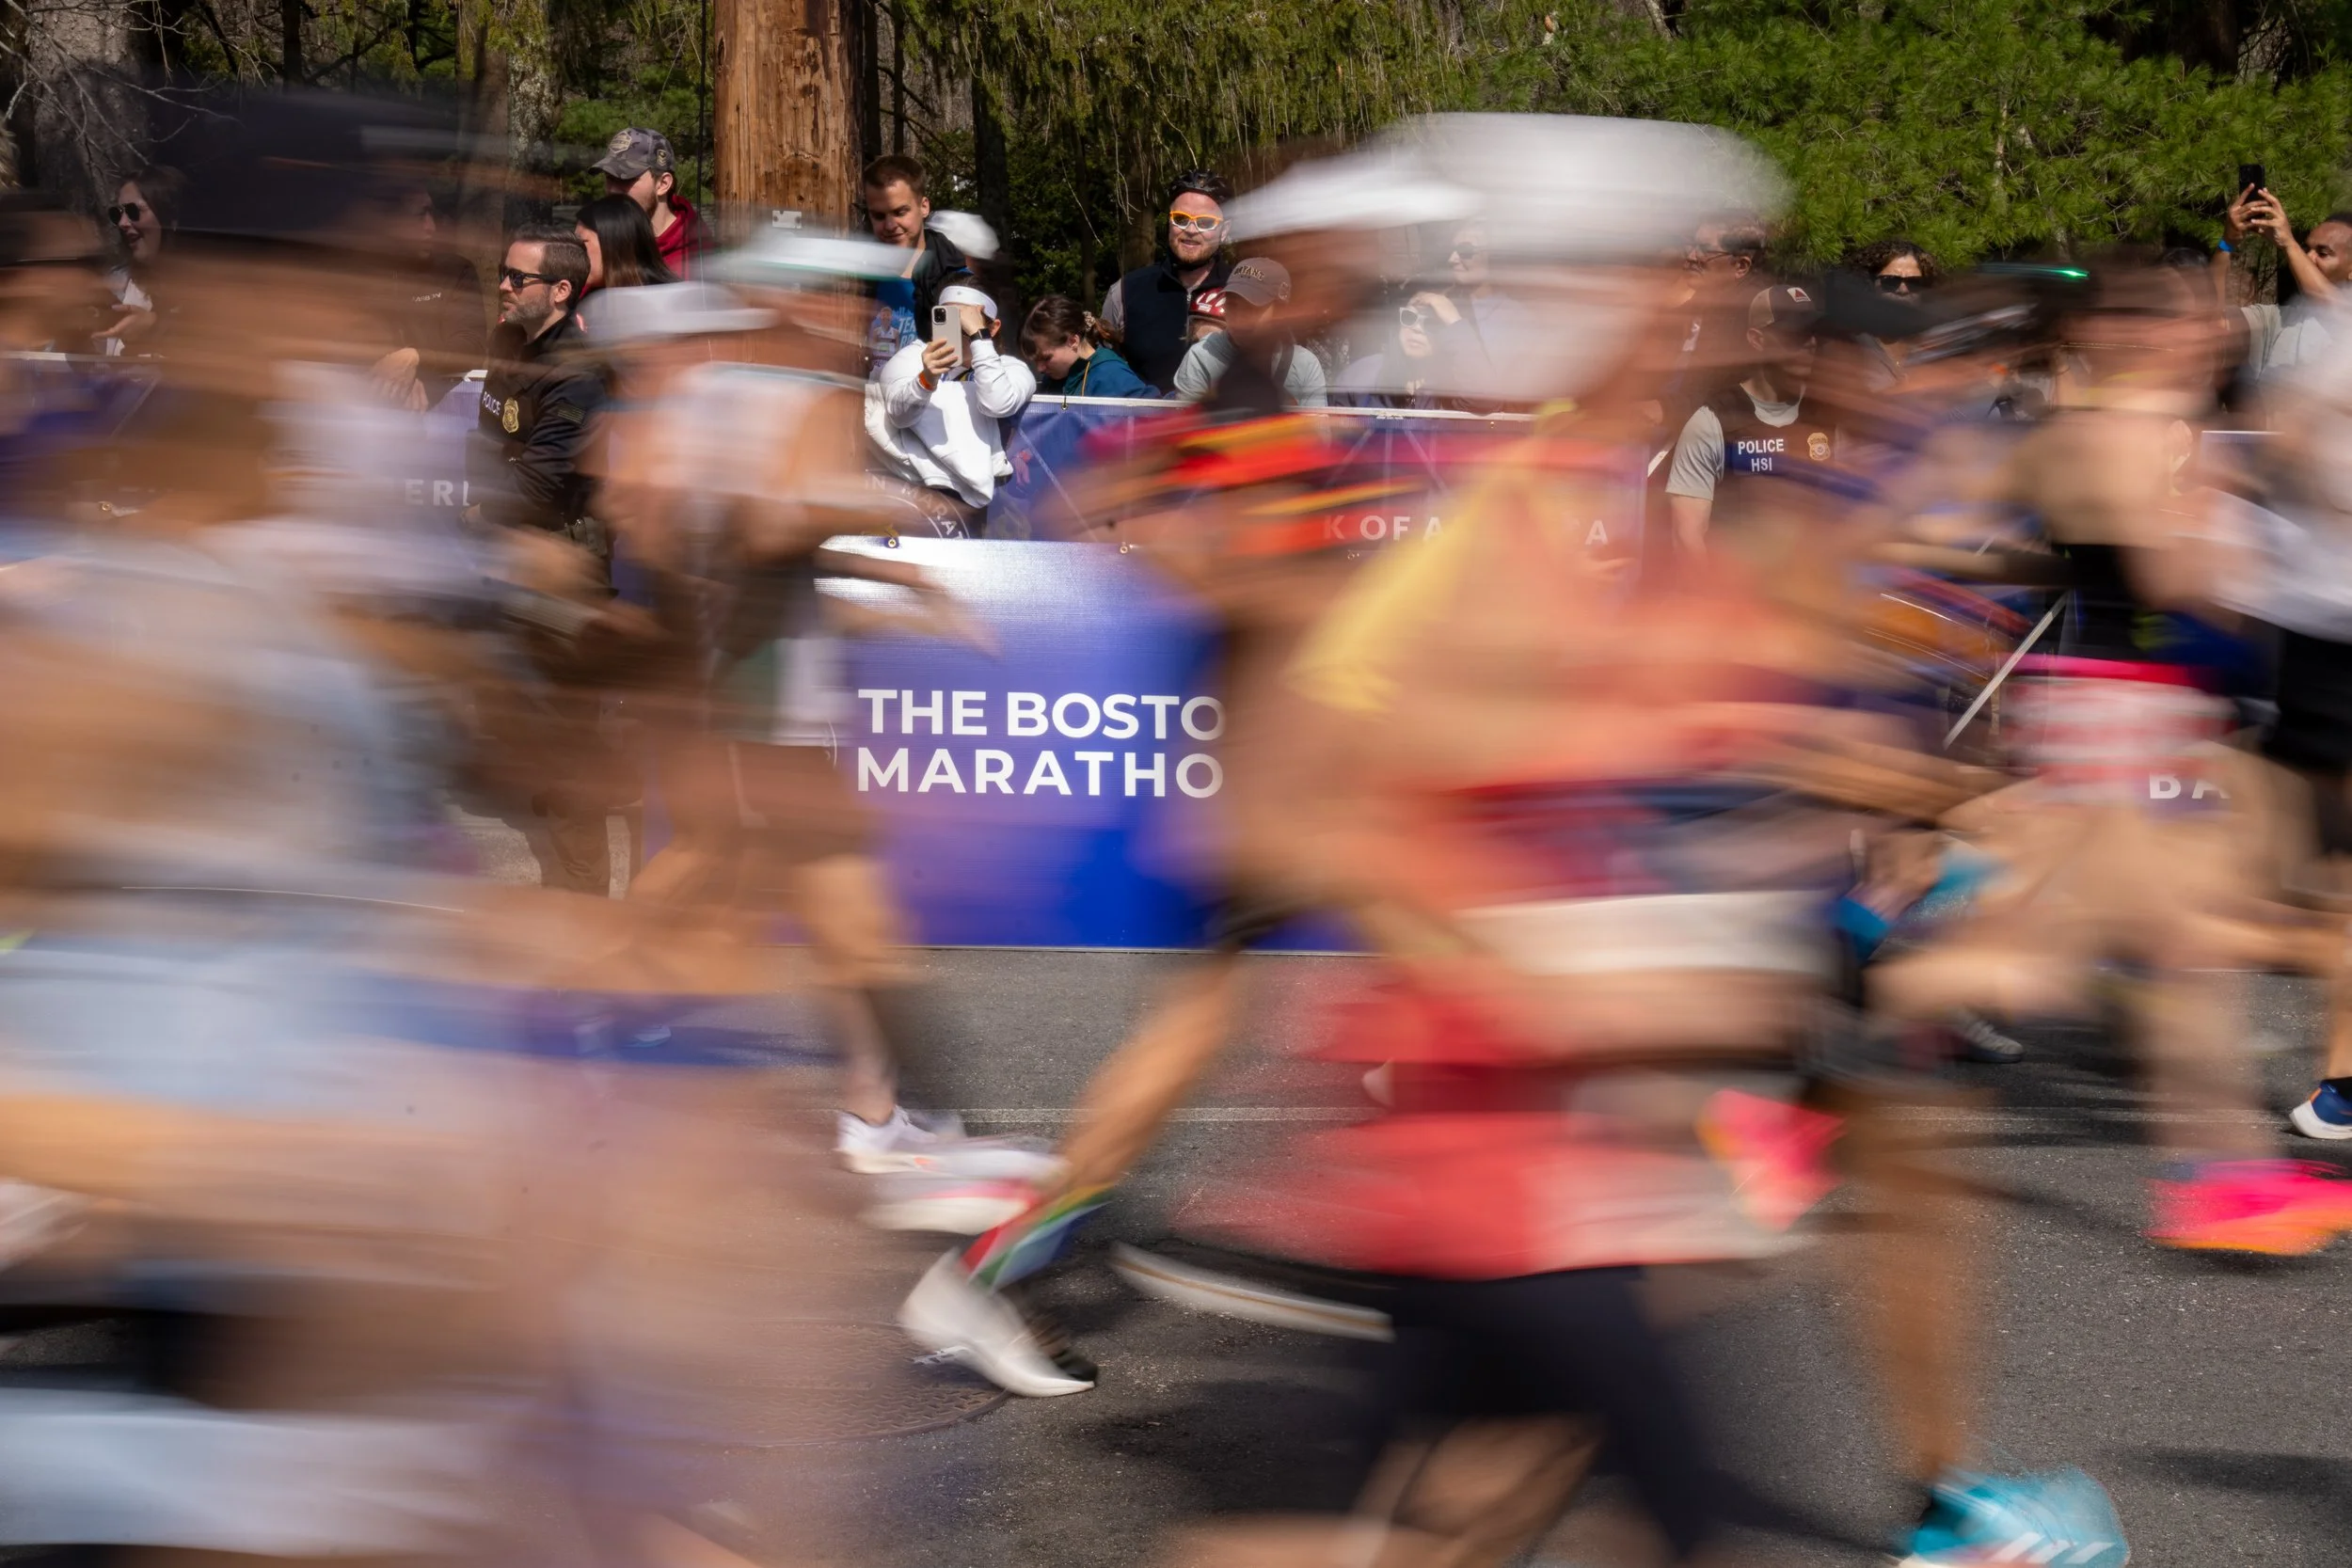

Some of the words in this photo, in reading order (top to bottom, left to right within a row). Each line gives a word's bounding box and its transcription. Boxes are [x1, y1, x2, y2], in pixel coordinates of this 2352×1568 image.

[898, 317, 917, 335] TEA
[482, 390, 501, 416] POLICE
[1738, 438, 1785, 455] POLICE
[1751, 457, 1772, 472] HSI
[1359, 515, 1411, 541] OF
[858, 689, 988, 736] THE
[1007, 691, 1224, 741] BOSTO
[857, 747, 1224, 799] MARATHO
